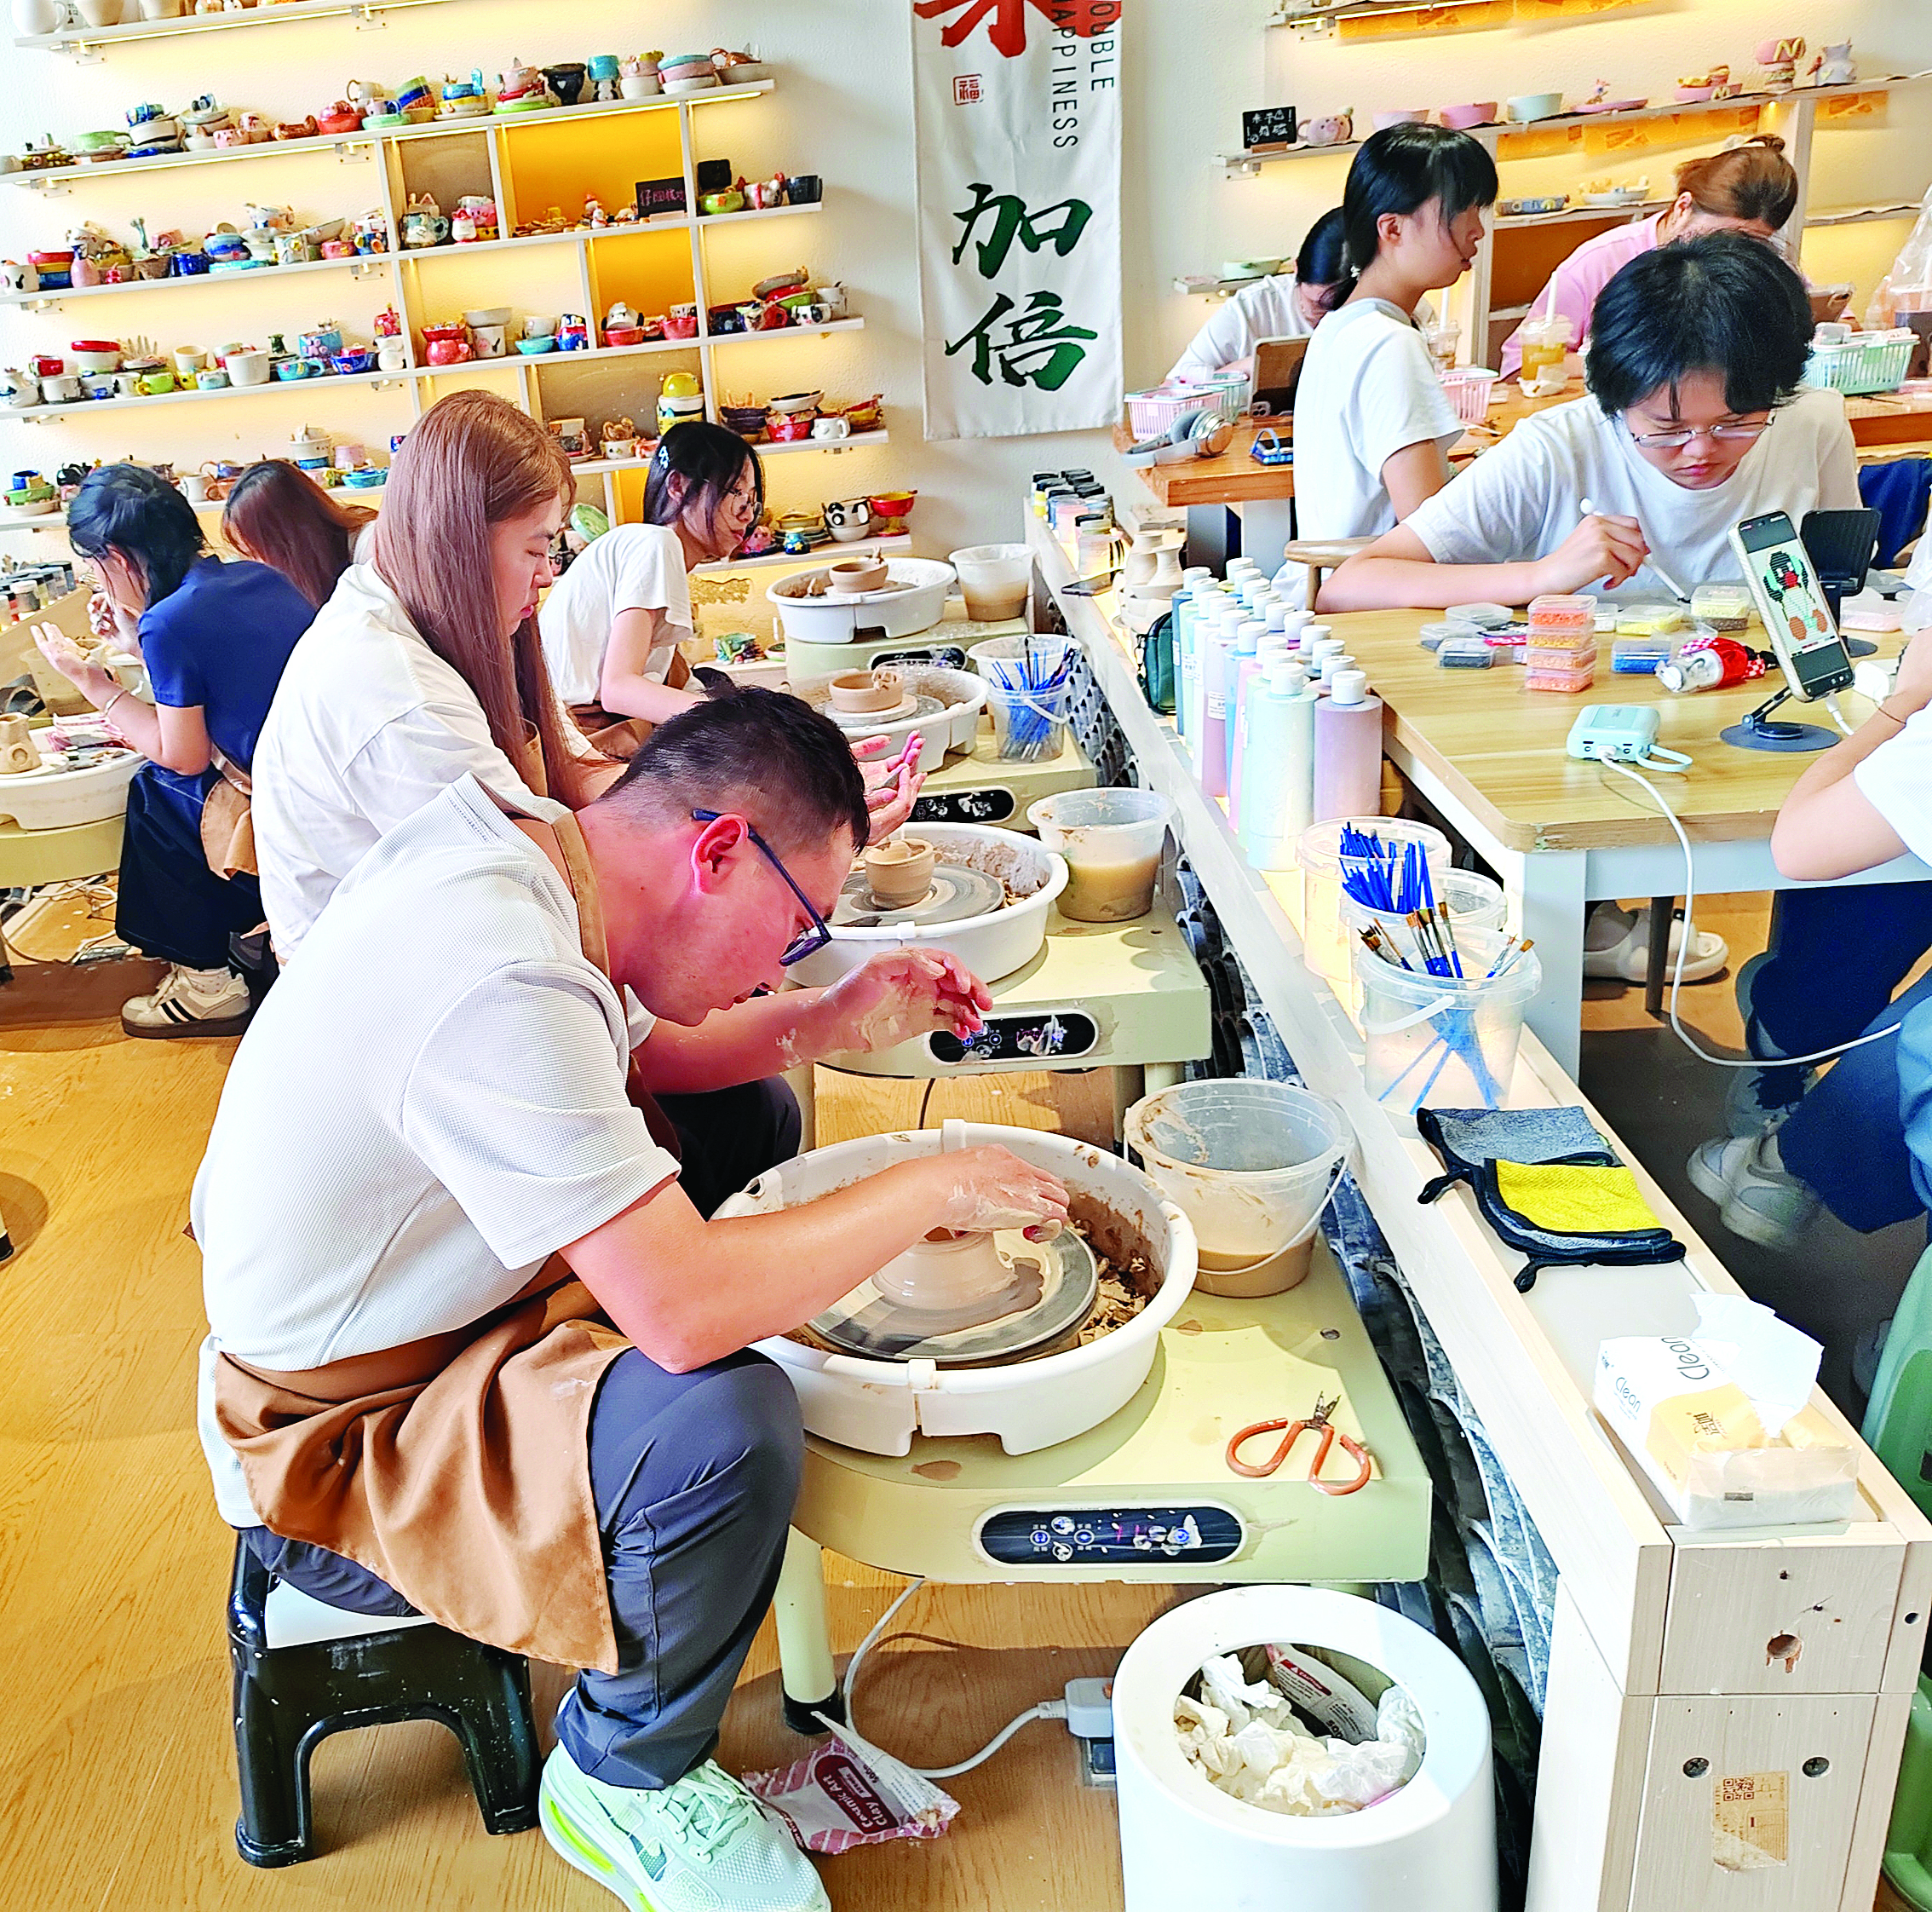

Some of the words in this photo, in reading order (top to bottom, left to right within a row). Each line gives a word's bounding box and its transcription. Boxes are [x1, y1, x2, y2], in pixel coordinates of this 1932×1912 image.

[1090, 3, 1114, 91] OUBLE
[957, 78, 980, 101] 福
[1052, 0, 1078, 148] APPINESS
[945, 182, 1098, 392] 加倍
[1660, 1337, 1710, 1380] Clean
[1614, 1376, 1641, 1414] Clean
[822, 1774, 842, 1794] Art
[837, 1794, 872, 1828] Ceramic
[865, 1798, 888, 1826] Clay
